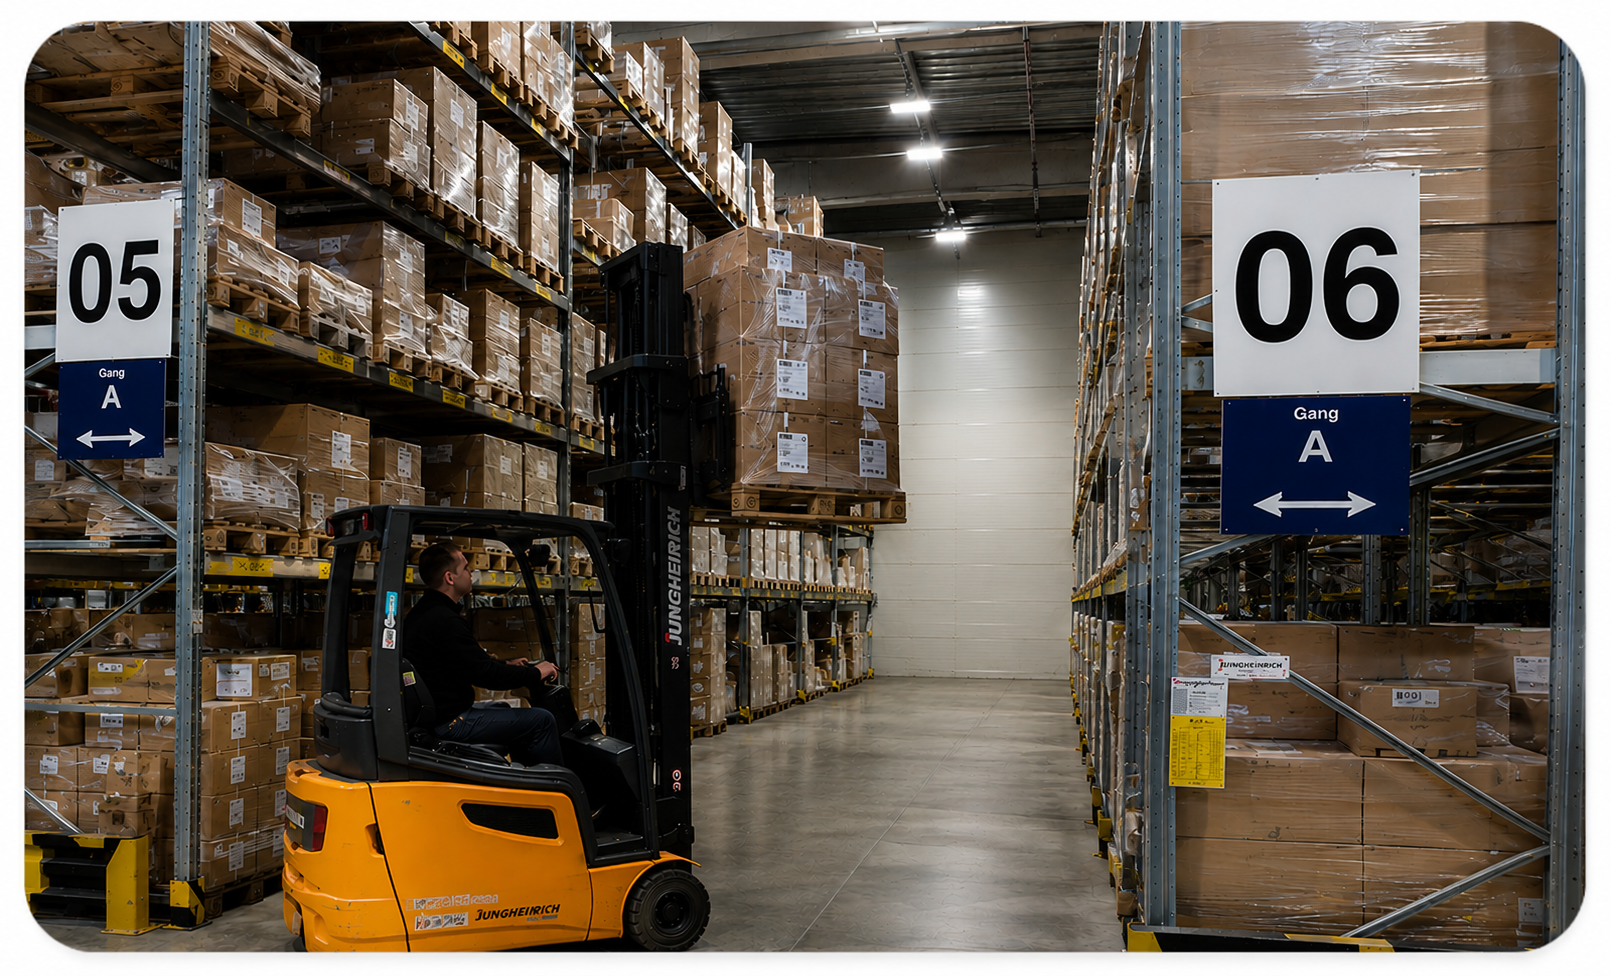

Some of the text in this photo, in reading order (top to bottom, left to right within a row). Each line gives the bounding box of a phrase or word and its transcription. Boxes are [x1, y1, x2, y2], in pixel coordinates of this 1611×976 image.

[69, 239, 161, 323] 05
[1235, 227, 1400, 343] 06
[99, 368, 125, 380] Gang
[101, 385, 121, 409] A
[1294, 407, 1339, 422] Gang
[1298, 430, 1333, 463] A
